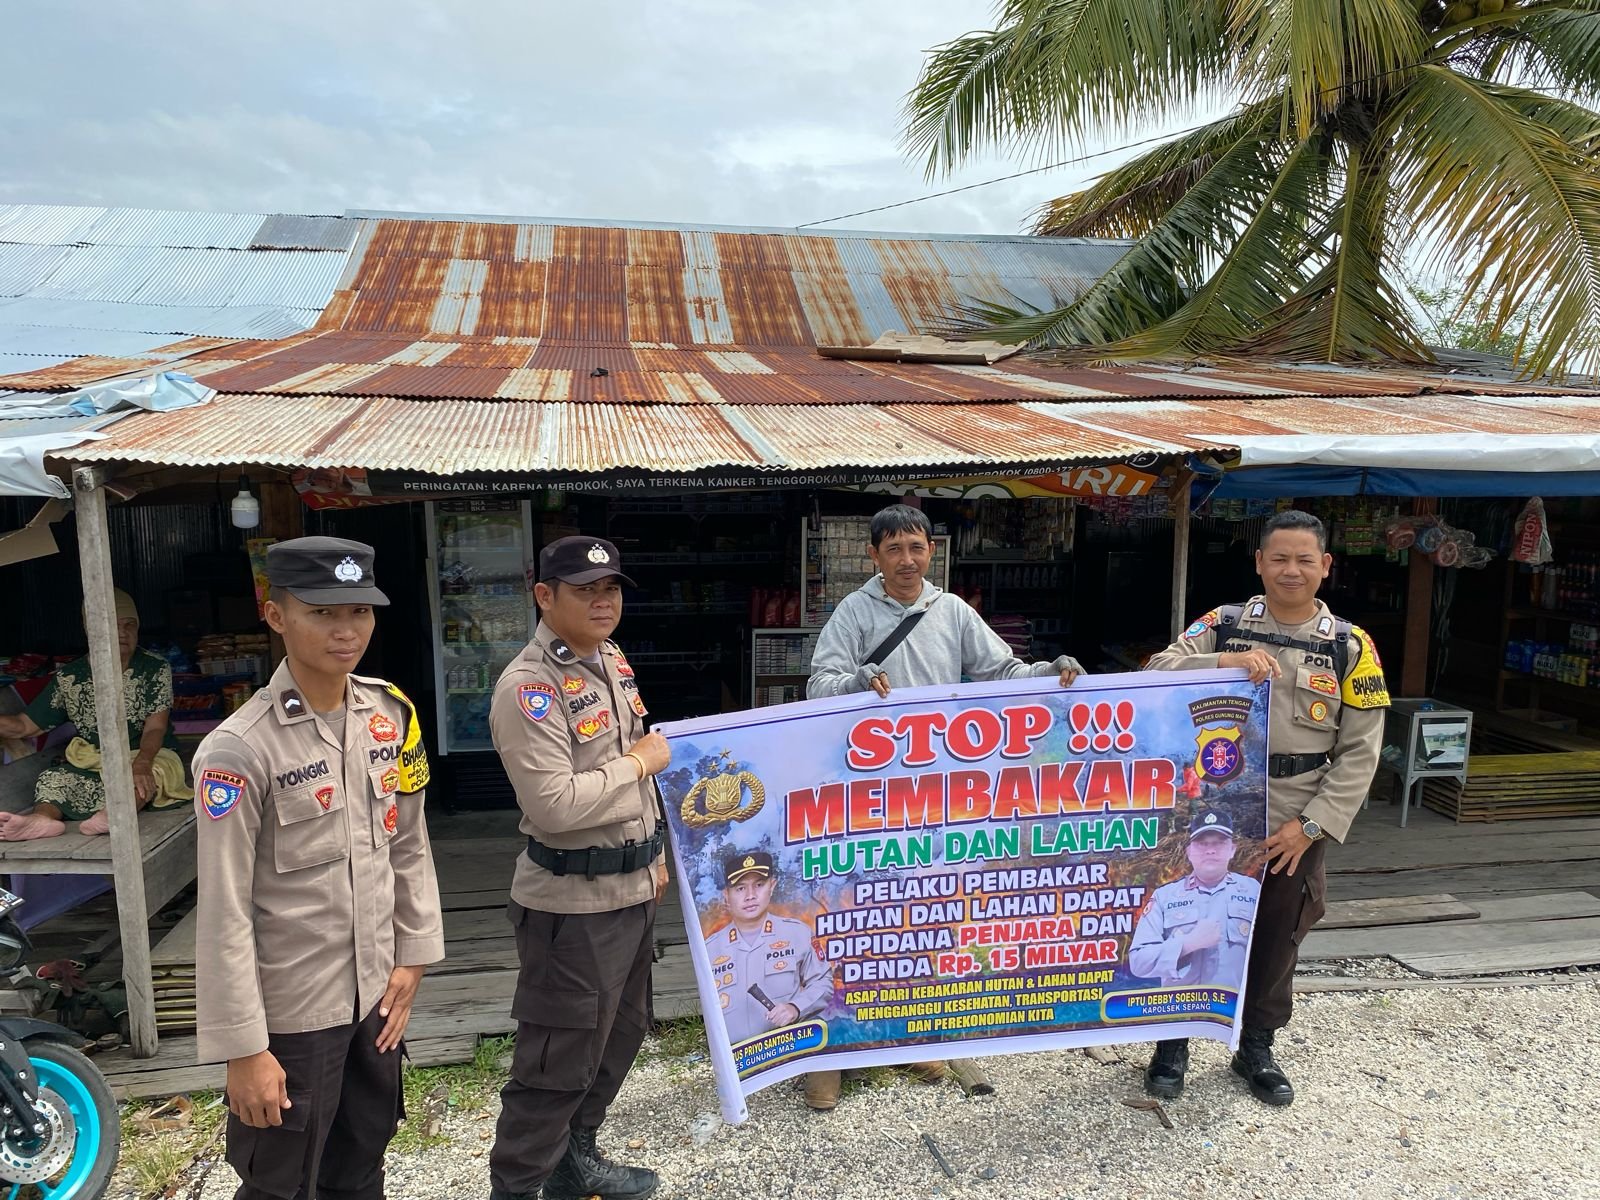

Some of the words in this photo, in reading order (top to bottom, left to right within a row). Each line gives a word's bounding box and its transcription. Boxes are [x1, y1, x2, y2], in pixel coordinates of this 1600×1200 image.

[403, 482, 488, 491] PERINGATAN:
[492, 482, 543, 491] KARENA
[547, 480, 613, 491] MEROKOK,
[616, 478, 646, 488] SAYA
[649, 477, 704, 488] TERKENA
[707, 477, 756, 487] KANKER
[759, 475, 850, 486] TENGGOROKAN.
[854, 474, 905, 484] LAYANAN
[1192, 699, 1228, 712] KALIMANTAN
[1228, 699, 1250, 707] TENGAH
[1195, 713, 1215, 723] POLRES
[1235, 713, 1246, 721] MAS
[847, 705, 1053, 771] STOP
[1069, 700, 1136, 752] !!!
[207, 772, 242, 785] BINMAS
[276, 759, 330, 789] YONGKI
[785, 759, 1177, 846] MEMBAKAR
[803, 834, 934, 881] HUTAN
[944, 826, 1020, 863] DAN
[1031, 817, 1160, 856] LAHAN
[855, 878, 953, 904] PELAKU
[965, 864, 1108, 894] PEMBAKAR
[816, 904, 904, 937] HUTAN
[910, 900, 964, 925] DAN
[972, 895, 1056, 920] LAHAN
[1063, 887, 1146, 913] DAPAT
[1167, 900, 1194, 910] DEBBY
[827, 931, 952, 961] DIPIDANA
[959, 919, 1075, 947] PENJARA
[1081, 916, 1134, 937] DAN
[766, 949, 795, 960] POLRI
[844, 957, 932, 984] DENDA
[938, 953, 981, 977] Rp.
[990, 949, 1019, 969] 15
[1025, 941, 1119, 967] MILYAR
[845, 991, 878, 1005] ASAP
[880, 989, 910, 1002] DARI
[912, 980, 983, 999] KEBAKARAN
[985, 978, 1024, 990] HUTAN
[1026, 977, 1035, 988] &
[1037, 974, 1077, 987] LAHAN
[1078, 970, 1115, 984] DAPAT
[1127, 996, 1146, 1007] IPTU
[1147, 994, 1174, 1006] DEBBY
[1212, 992, 1228, 1004] S.E.
[857, 1004, 941, 1021] MENGGANGGU
[944, 997, 1013, 1013] KESEHATAN,
[1015, 988, 1103, 1006] TRANSPORTASI
[1142, 1003, 1181, 1015] KAPOLSEK
[1182, 1003, 1211, 1011] SEPANG
[907, 1019, 931, 1033] DAN
[933, 1012, 1026, 1031] PEREKONOMIAN
[1028, 1009, 1055, 1022] KITA
[744, 1042, 762, 1058] PRIYO
[763, 1031, 796, 1050] SANTOSA,
[797, 1027, 814, 1040] S.I.K.
[745, 1048, 777, 1066] GUNUNG
[778, 1043, 795, 1054] MAS
